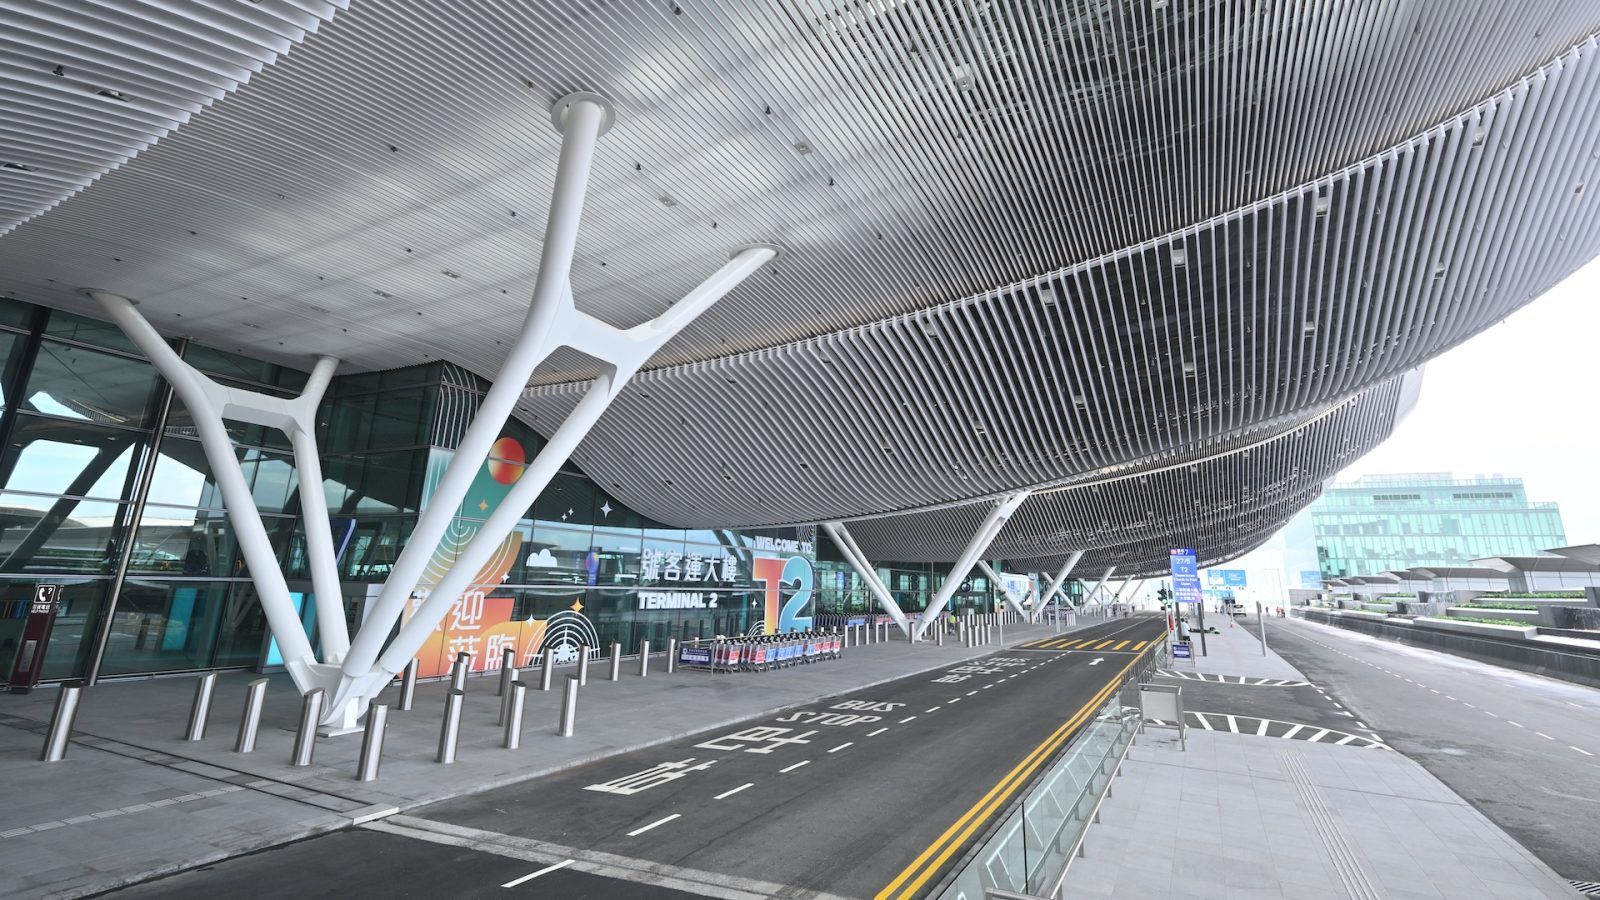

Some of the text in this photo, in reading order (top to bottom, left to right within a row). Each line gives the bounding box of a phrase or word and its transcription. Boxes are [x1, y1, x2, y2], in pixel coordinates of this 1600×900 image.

[755, 536, 813, 554] WELCOME TO
[615, 547, 738, 583] 二號客運大樓
[637, 592, 718, 609] TERMINAL 2
[752, 555, 815, 636] T2
[829, 700, 906, 712] BUS
[775, 711, 883, 727] STOP
[693, 726, 820, 754] 巴士
